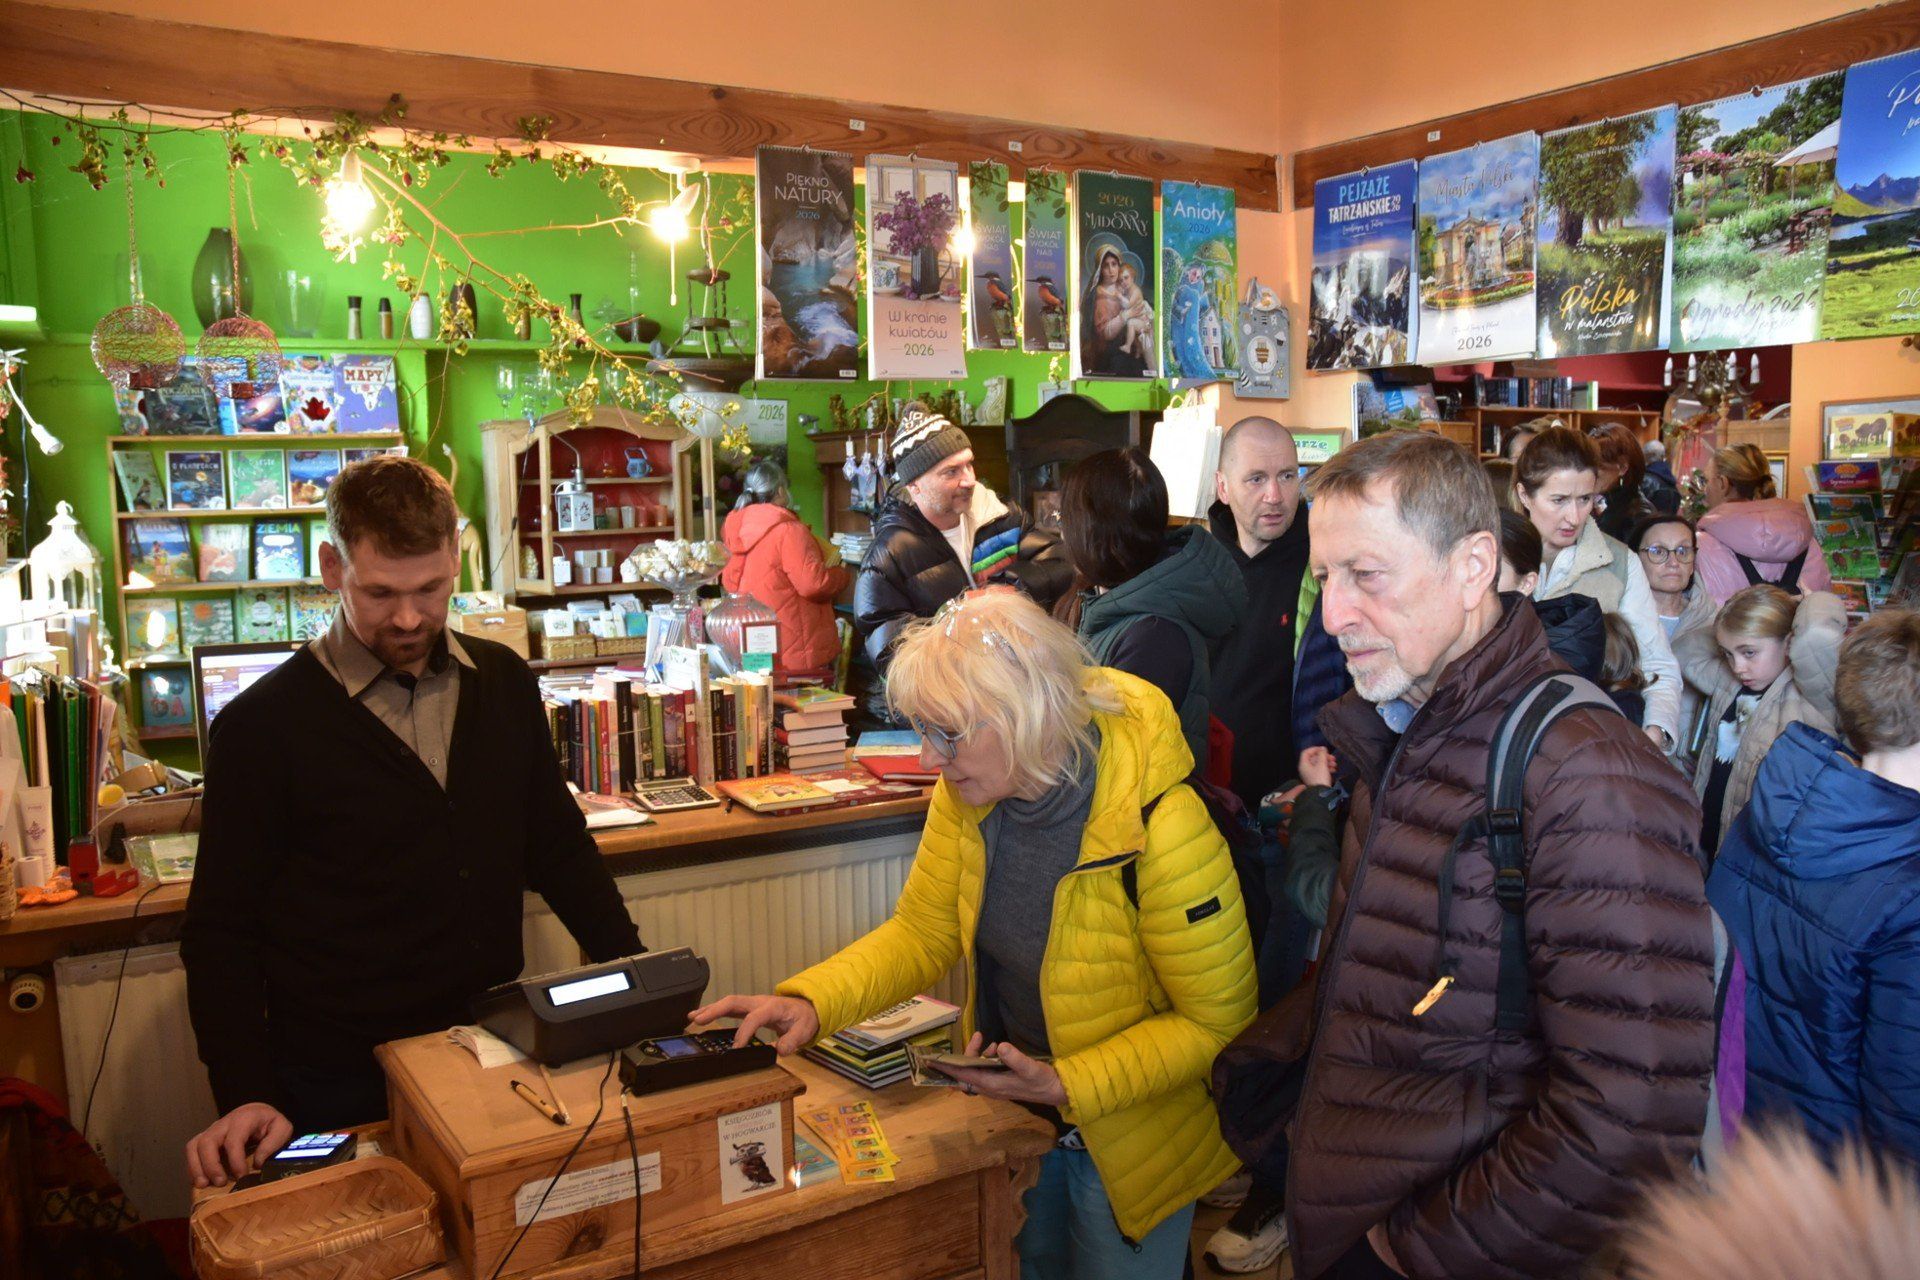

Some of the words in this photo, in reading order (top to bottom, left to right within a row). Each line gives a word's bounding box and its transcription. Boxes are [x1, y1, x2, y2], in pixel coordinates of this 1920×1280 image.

[786, 172, 829, 188] PIĘKNO
[774, 185, 843, 205] NATURY
[1339, 175, 1390, 204] PEJZAŻE
[1173, 199, 1226, 226] Anioły
[1328, 196, 1391, 224] TATRZAŃSKIE
[1028, 225, 1062, 240] ŚWIAT
[1188, 222, 1211, 234] 2026
[1030, 239, 1060, 249] WOKÓŁ
[1036, 248, 1053, 256] NAS
[1560, 276, 1641, 320] Polska
[1769, 287, 1819, 314] 2026
[888, 310, 902, 323] W
[904, 311, 947, 324] krainie
[889, 326, 948, 339] kwiatów
[904, 343, 935, 356] 2026
[1457, 335, 1492, 350] 2026
[344, 369, 384, 382] MAPY
[758, 404, 784, 421] 2026
[256, 523, 301, 534] ZIEMIA
